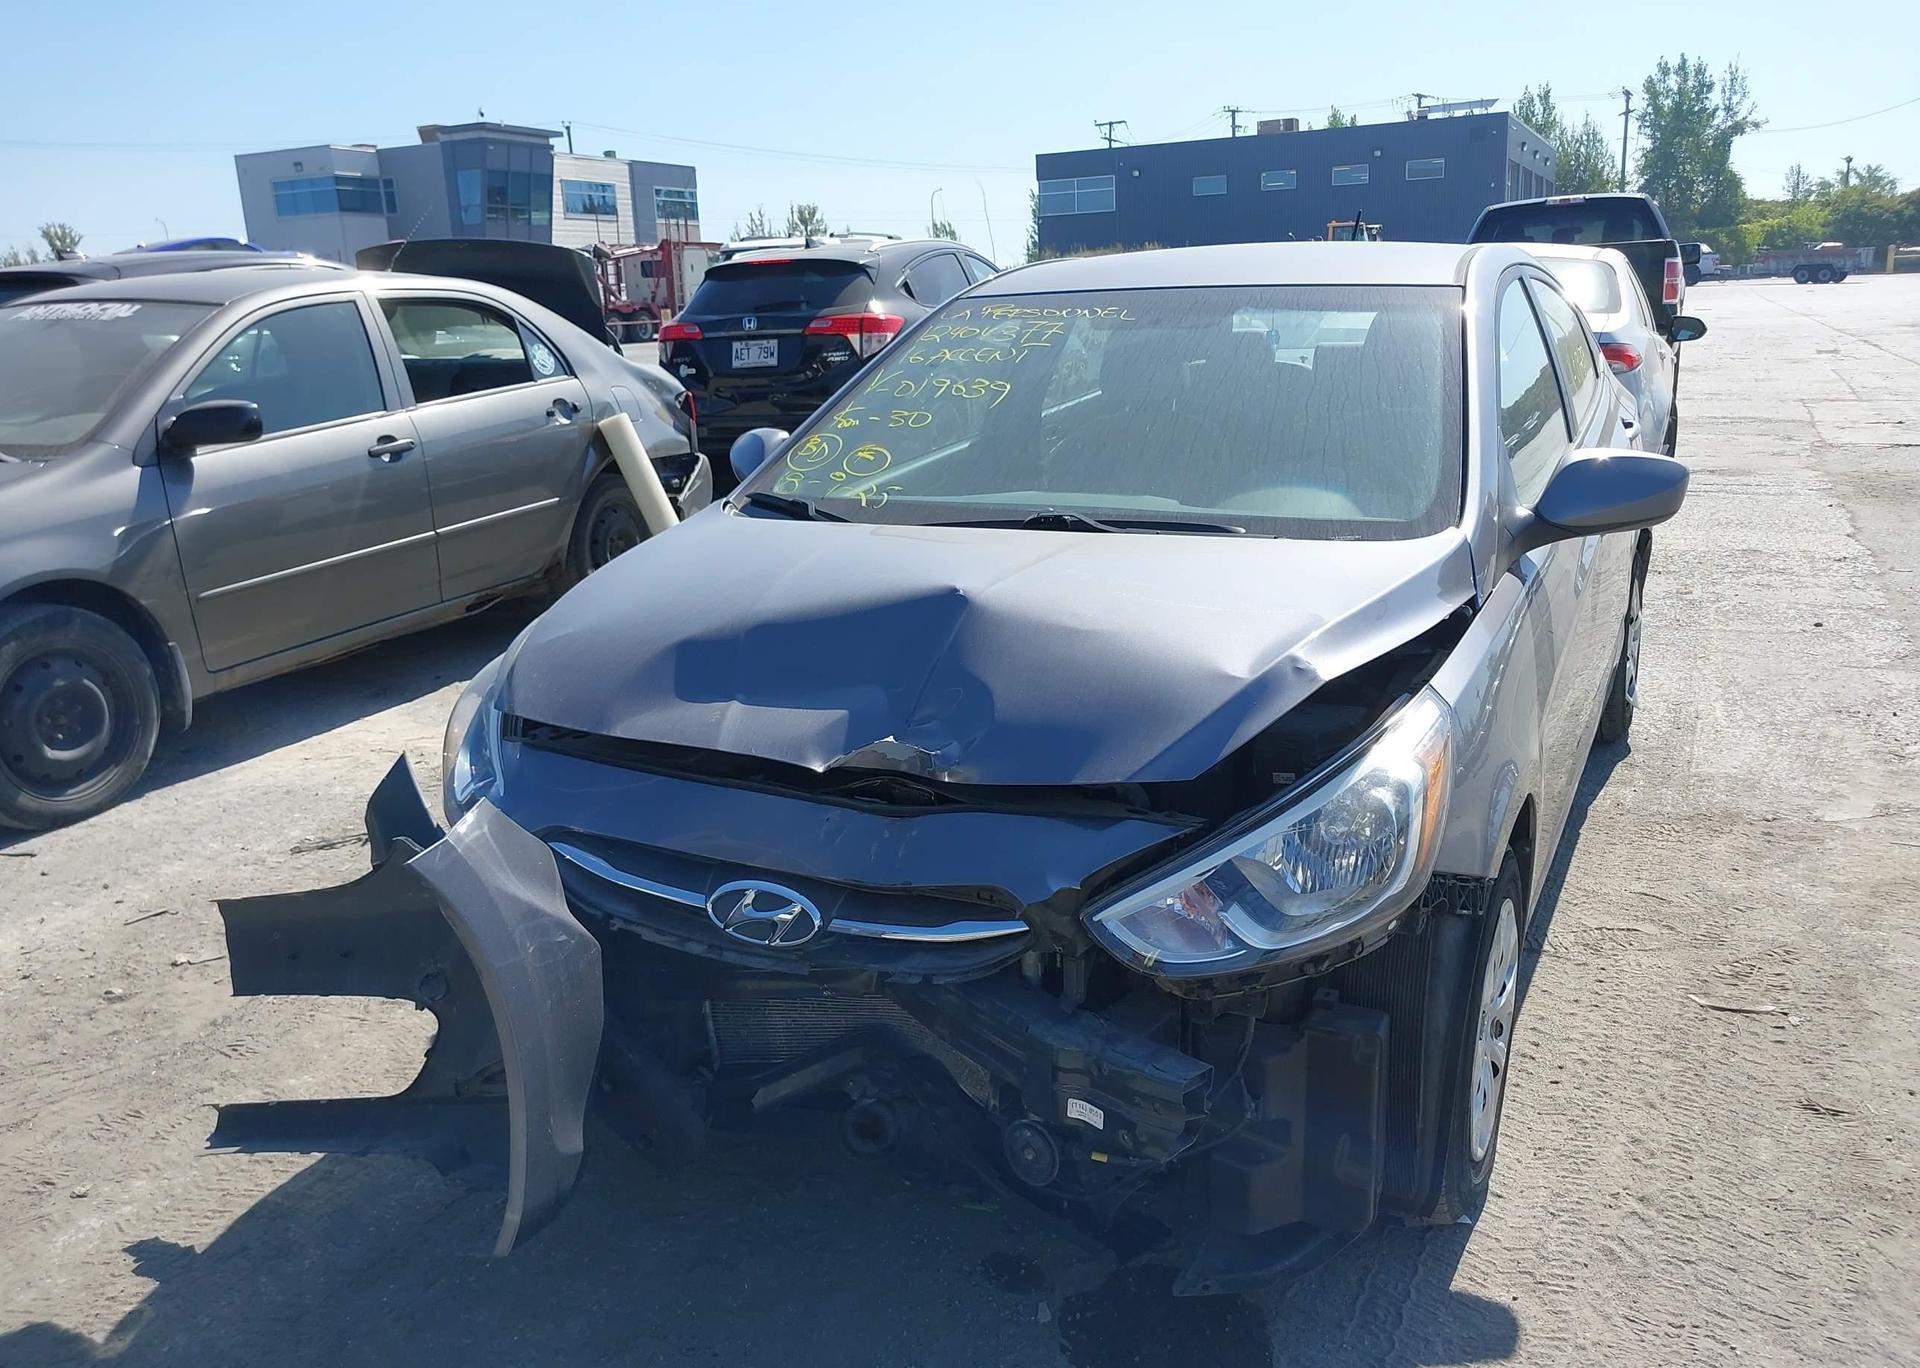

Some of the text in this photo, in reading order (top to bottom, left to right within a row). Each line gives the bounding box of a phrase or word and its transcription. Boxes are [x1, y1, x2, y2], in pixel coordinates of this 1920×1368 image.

[940, 308, 971, 321] LA
[733, 346, 776, 362] AET 79W
